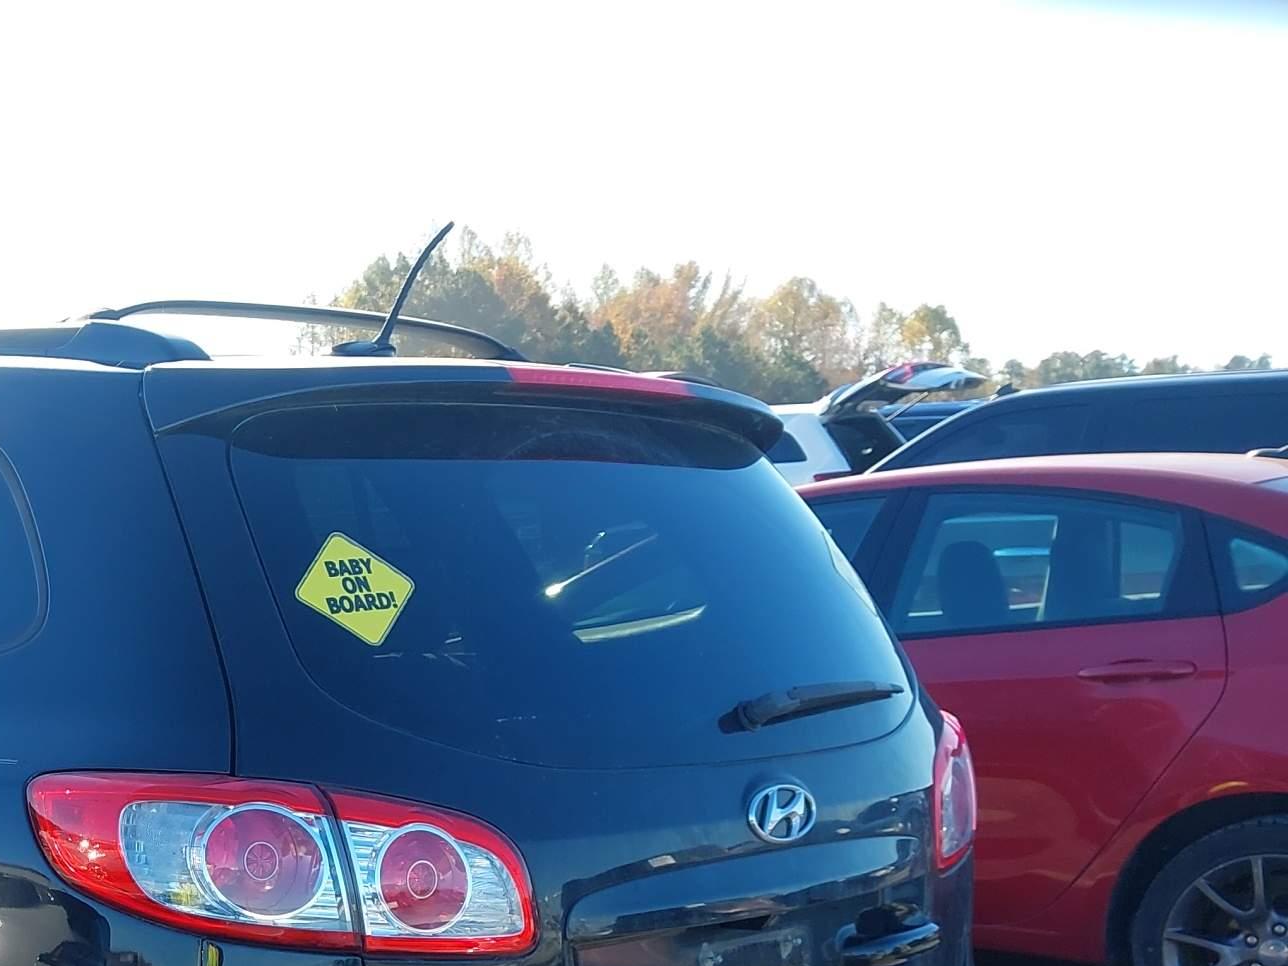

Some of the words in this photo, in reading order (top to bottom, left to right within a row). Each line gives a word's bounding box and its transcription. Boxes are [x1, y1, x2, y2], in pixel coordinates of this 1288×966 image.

[324, 558, 373, 577] BABY
[341, 576, 372, 594] ON
[326, 591, 399, 615] BOARD!
